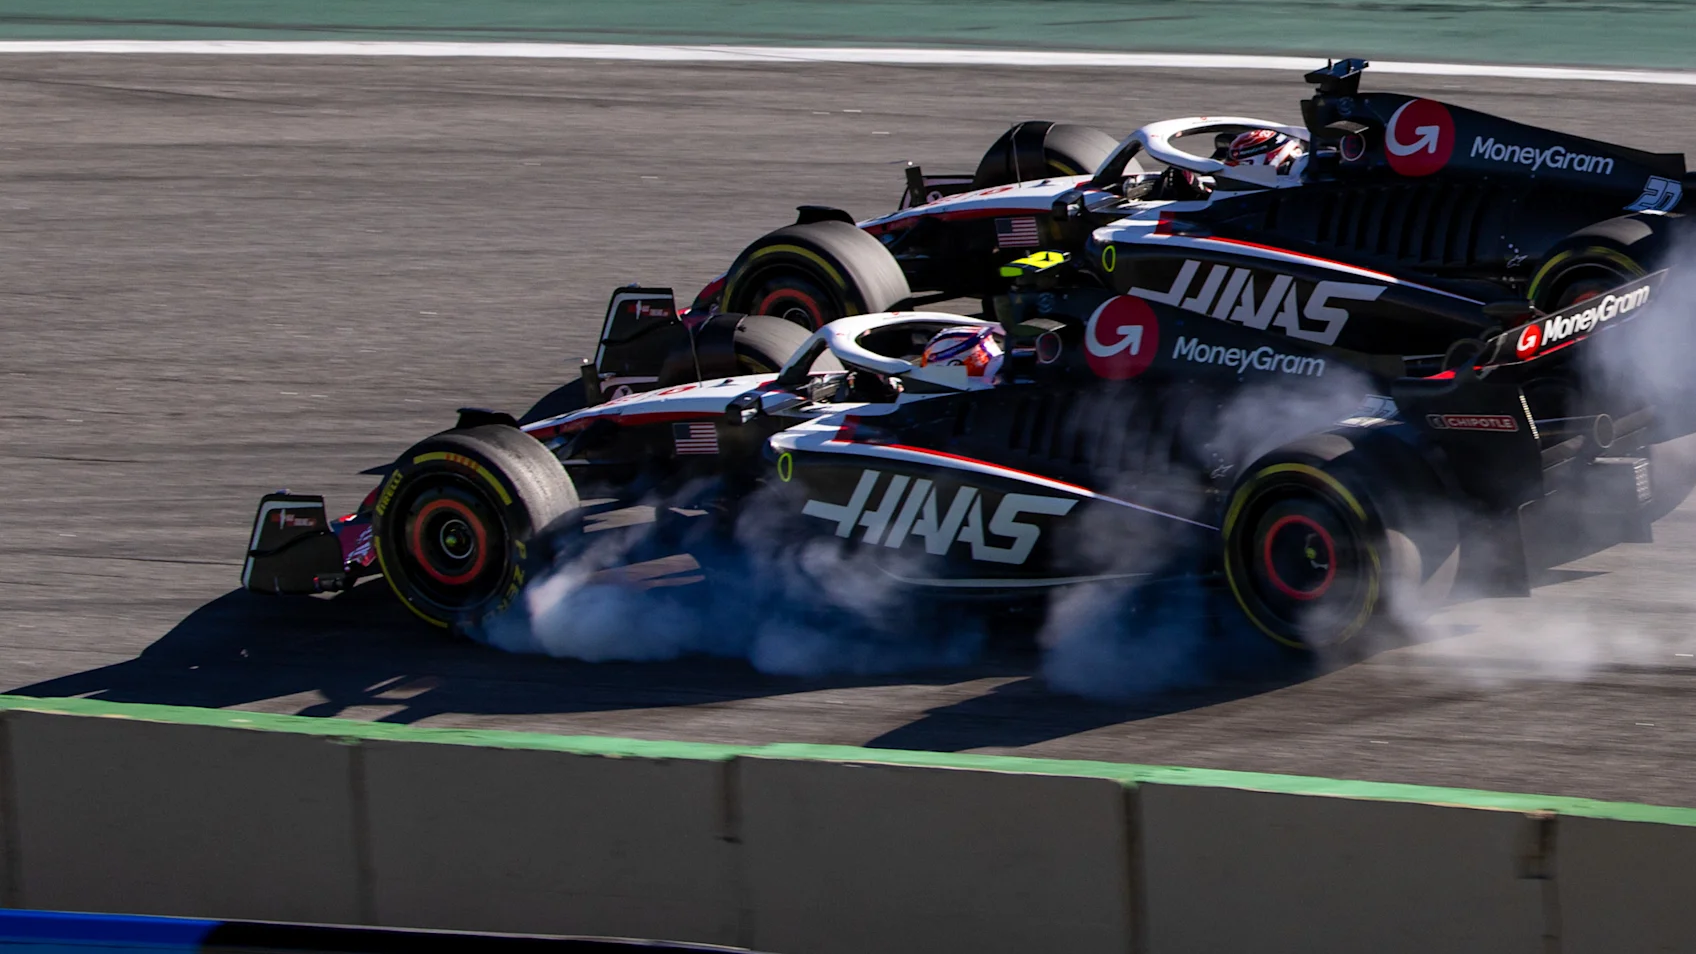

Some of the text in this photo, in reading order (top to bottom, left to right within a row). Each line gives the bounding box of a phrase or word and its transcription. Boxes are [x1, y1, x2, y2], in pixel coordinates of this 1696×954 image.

[1470, 134, 1614, 176] MoneyGram
[1541, 285, 1650, 347] MoneyGram
[1172, 336, 1326, 377] MoneyGram
[1447, 417, 1513, 429] CHIPOTLE
[801, 468, 1079, 565] HAAS
